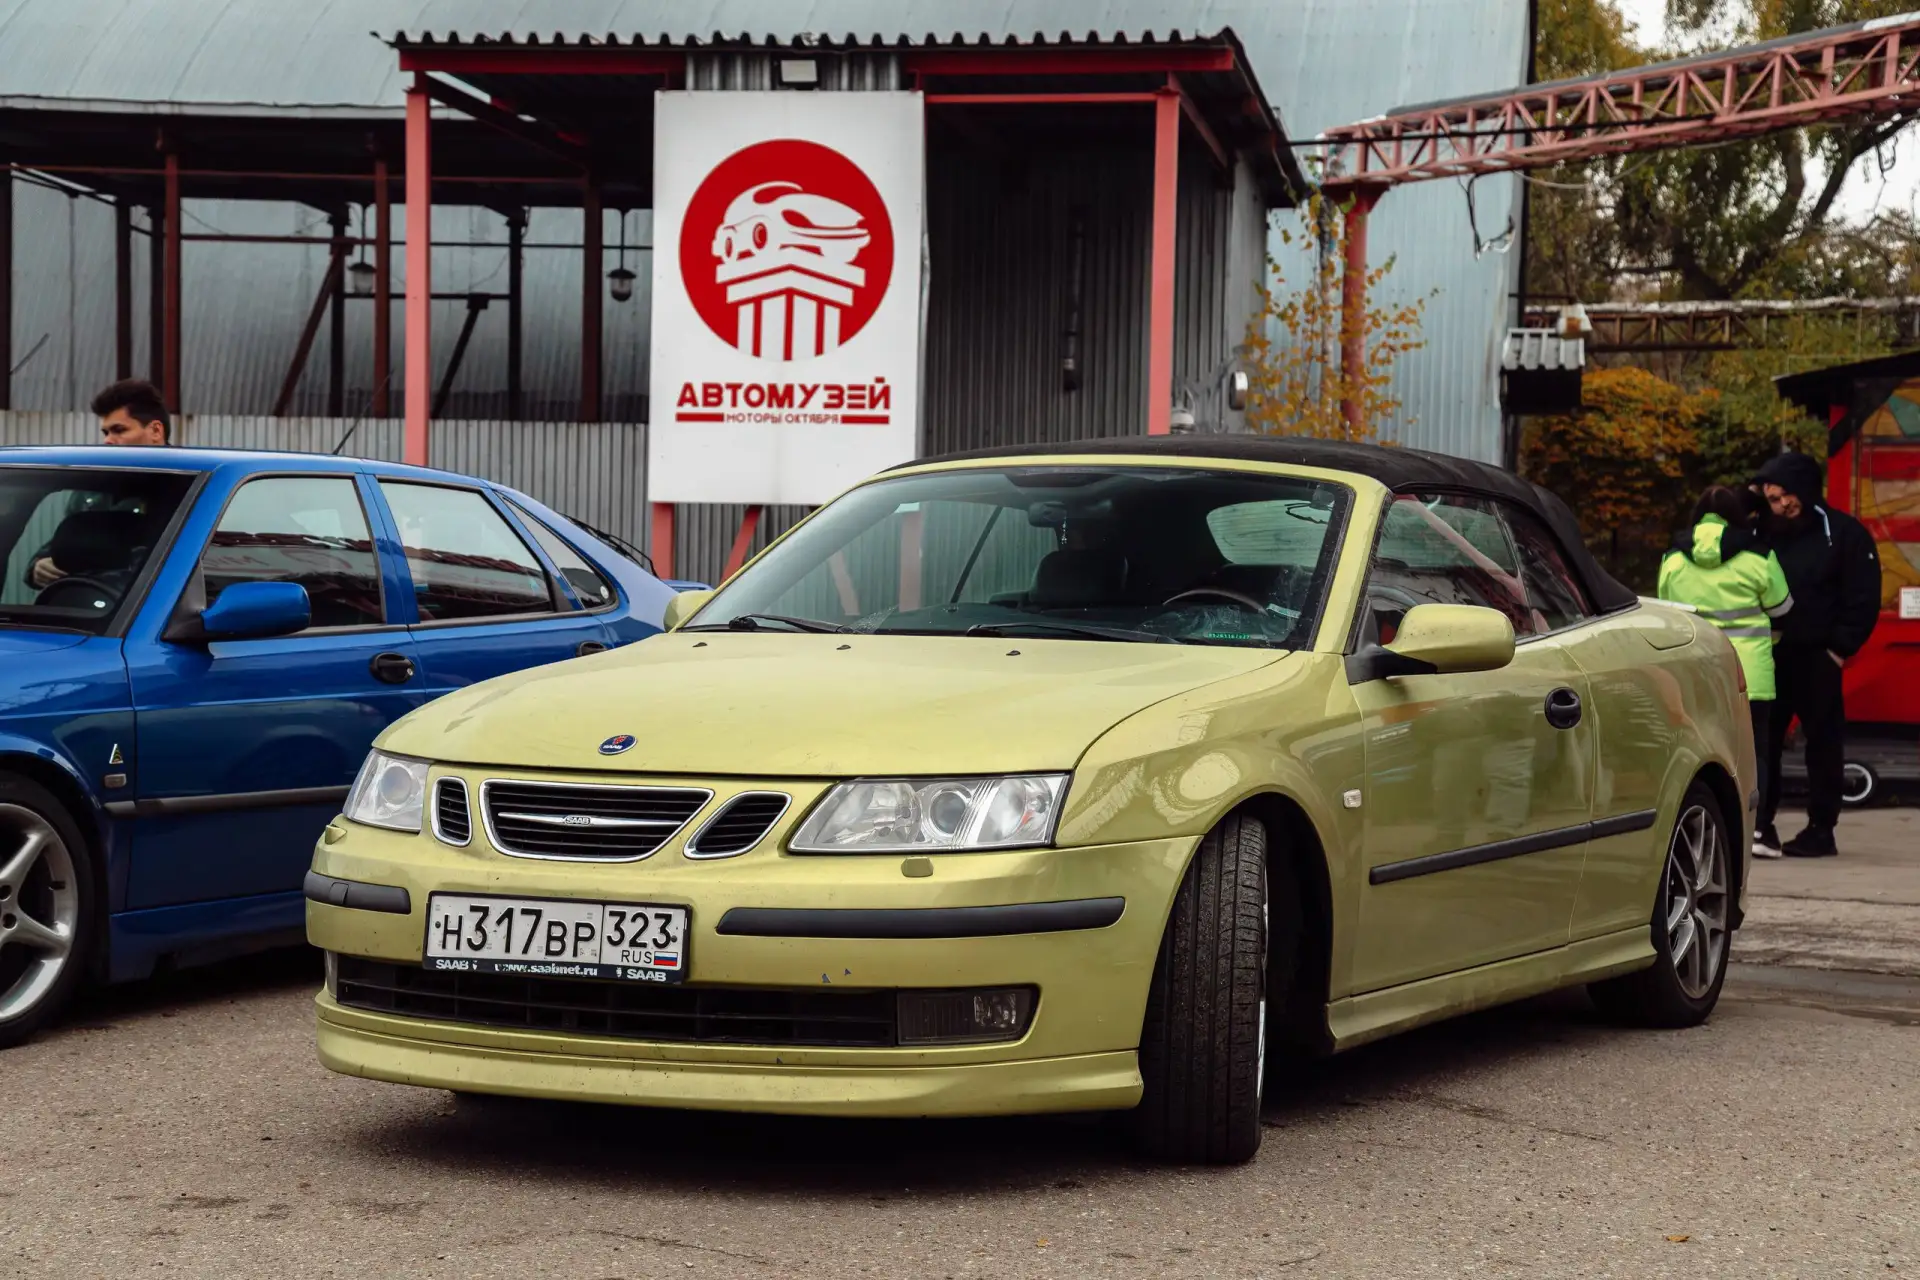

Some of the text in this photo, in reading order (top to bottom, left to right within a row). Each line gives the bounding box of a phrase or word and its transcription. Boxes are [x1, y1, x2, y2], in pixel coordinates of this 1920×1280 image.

[676, 377, 891, 410] АВТОМУЗЕЙ
[785, 413, 839, 424] ОКТЯБРЯ
[565, 816, 589, 825] SAAB
[441, 904, 672, 958] Н317ВР 323
[621, 949, 652, 964] RUS
[436, 959, 469, 971] SAAB
[626, 968, 667, 982] SAAB
